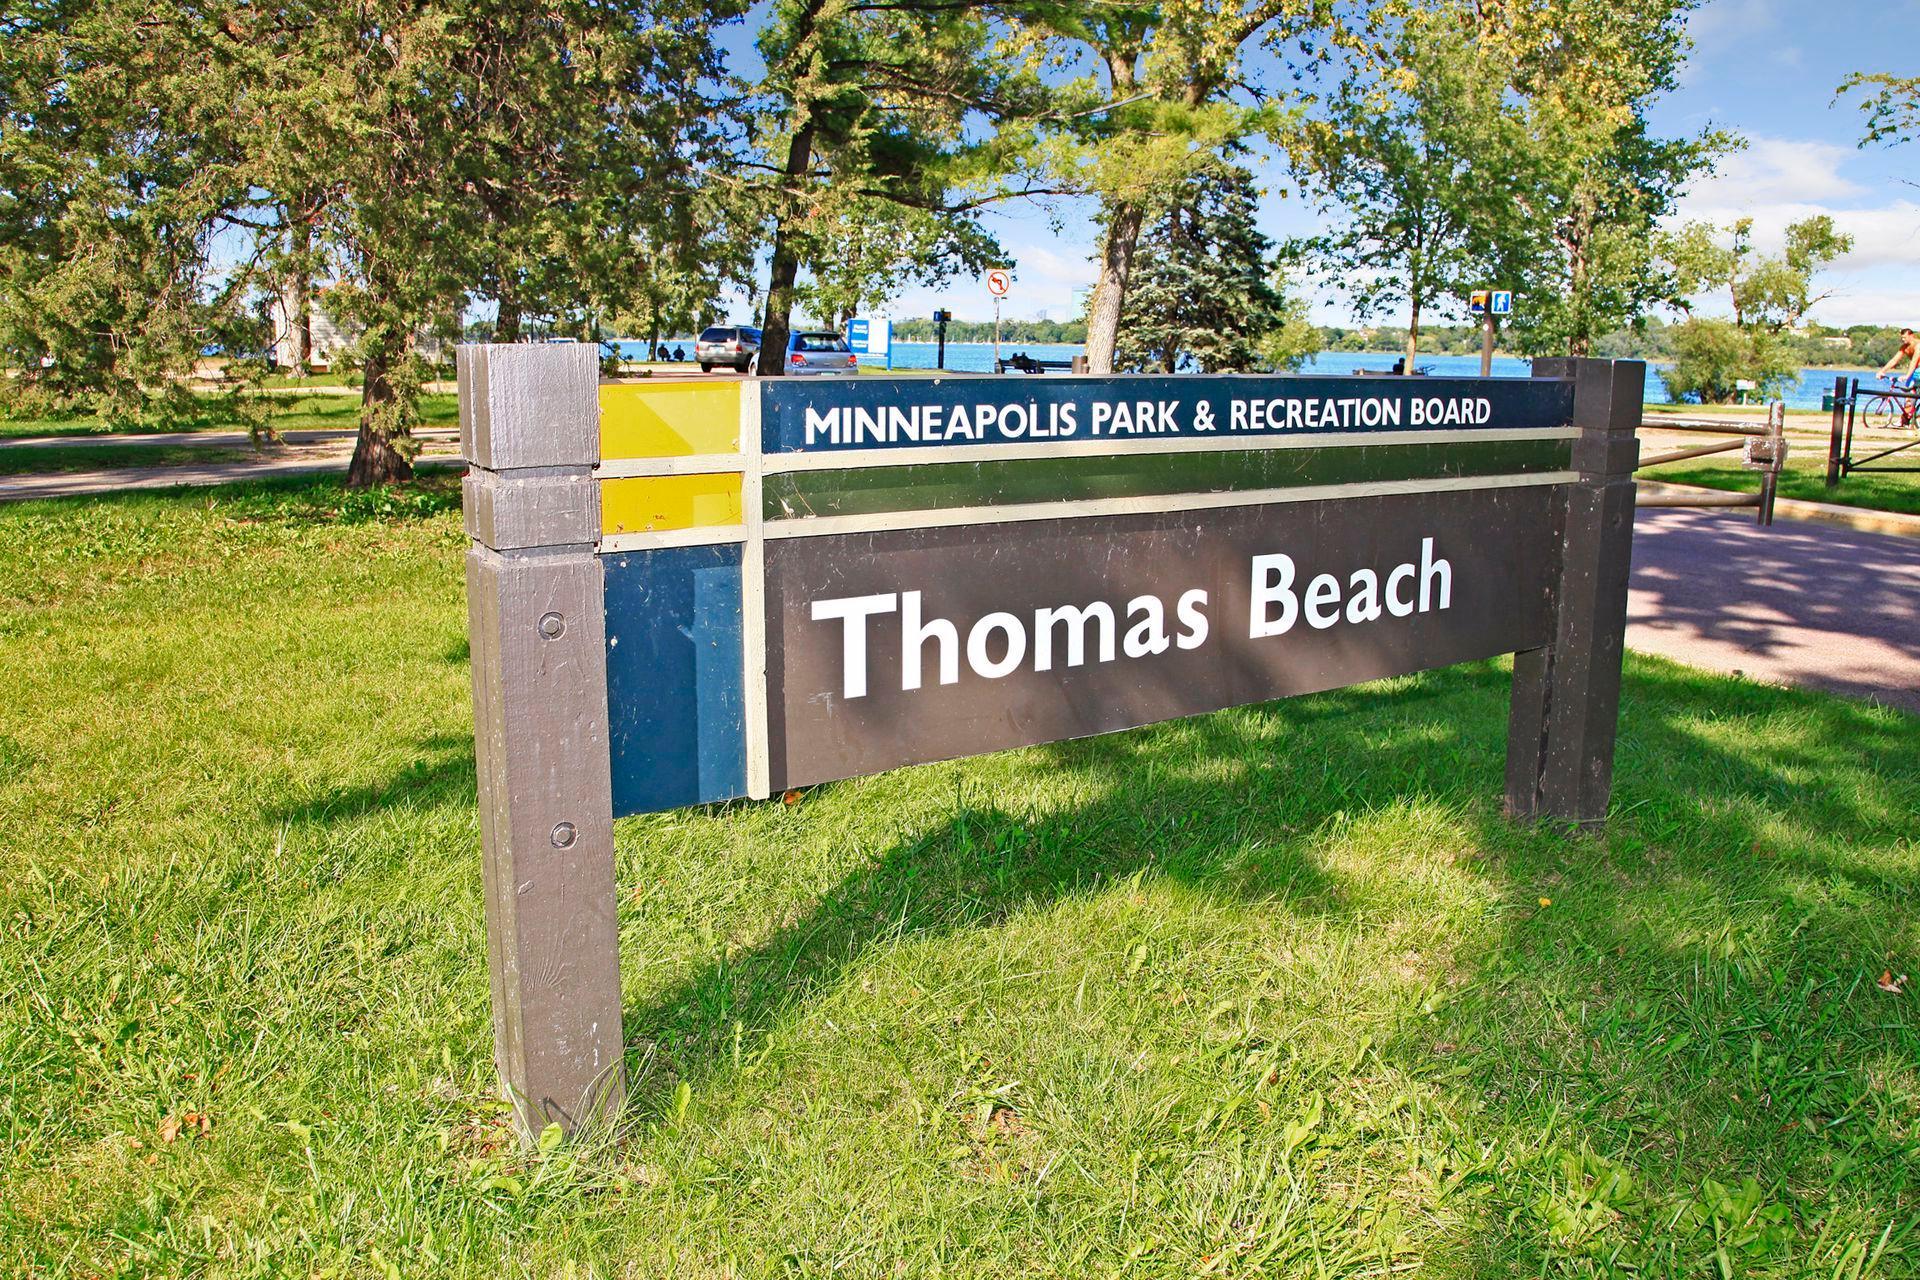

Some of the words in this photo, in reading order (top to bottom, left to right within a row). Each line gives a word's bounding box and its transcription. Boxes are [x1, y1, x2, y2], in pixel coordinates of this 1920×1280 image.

[806, 402, 1077, 444] MINNEAPOLIS
[1093, 401, 1180, 434] PARK
[1193, 400, 1217, 431] &
[1230, 398, 1401, 430] RECREATION
[1410, 397, 1491, 425] BOARD
[810, 588, 1209, 699] Thomas
[1249, 537, 1452, 640] Beach
